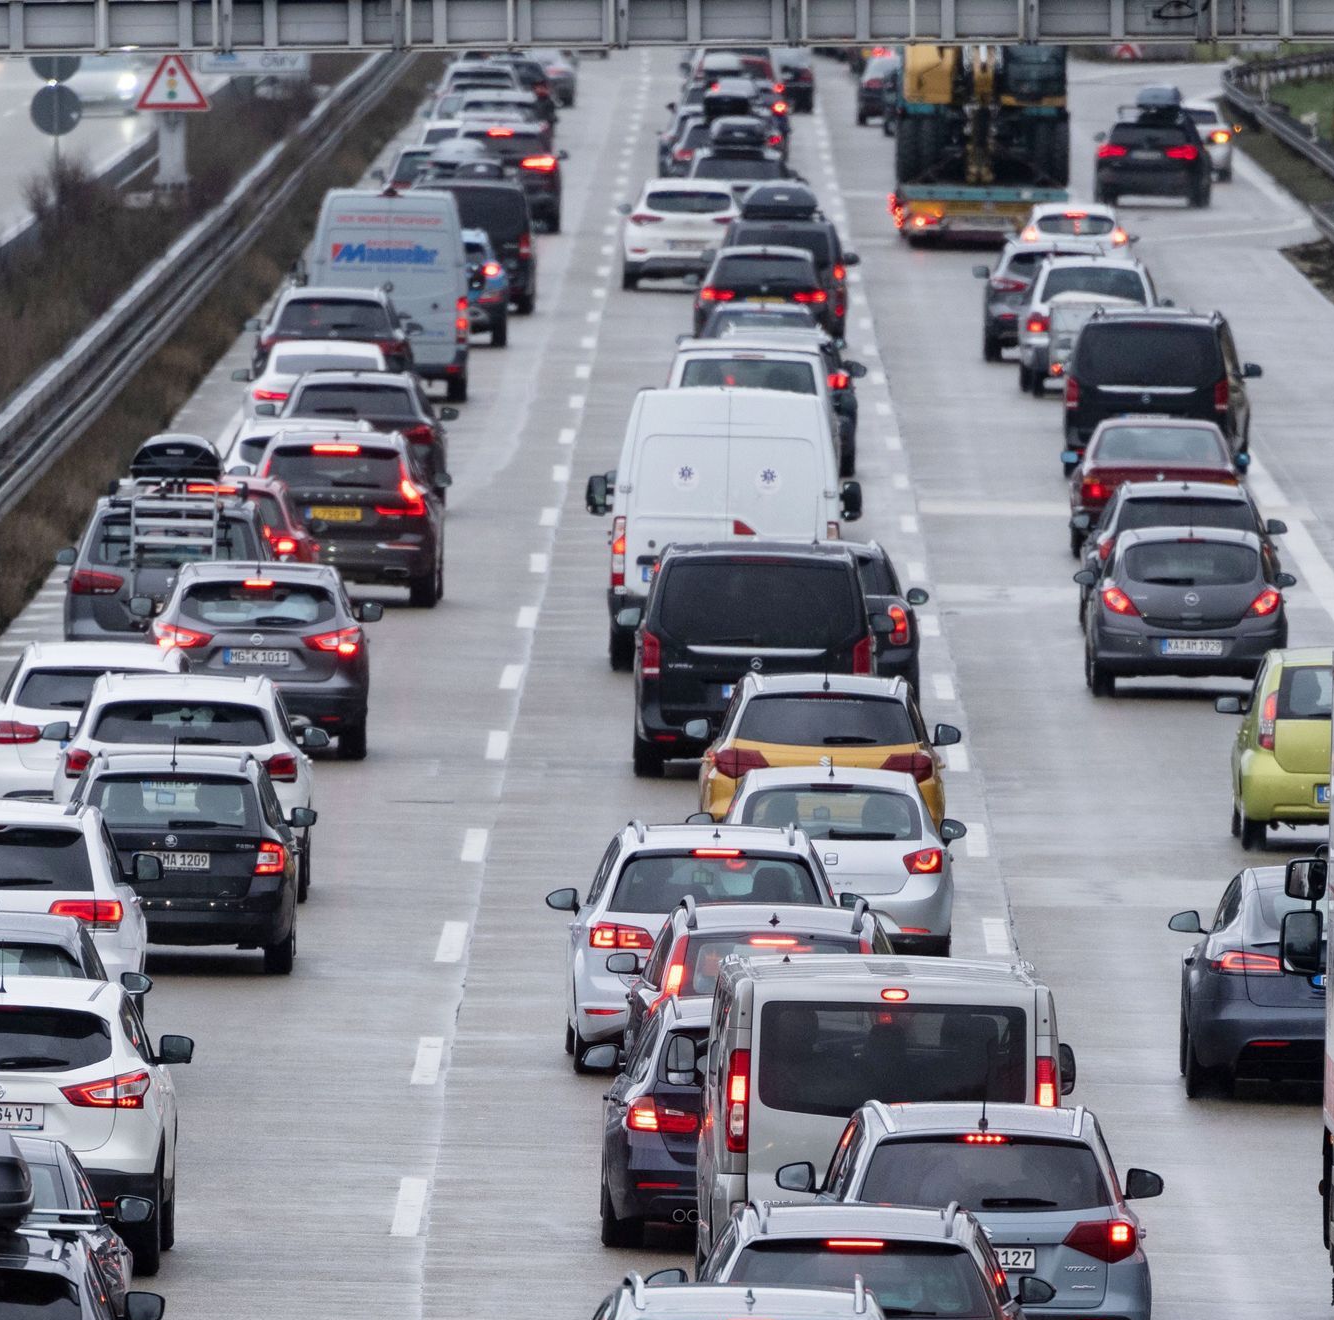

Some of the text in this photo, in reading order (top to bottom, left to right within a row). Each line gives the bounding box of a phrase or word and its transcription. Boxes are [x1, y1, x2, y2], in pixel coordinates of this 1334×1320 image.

[230, 651, 287, 663] MG K 1011
[180, 853, 208, 867] 1209
[15, 1108, 33, 1122] VJ
